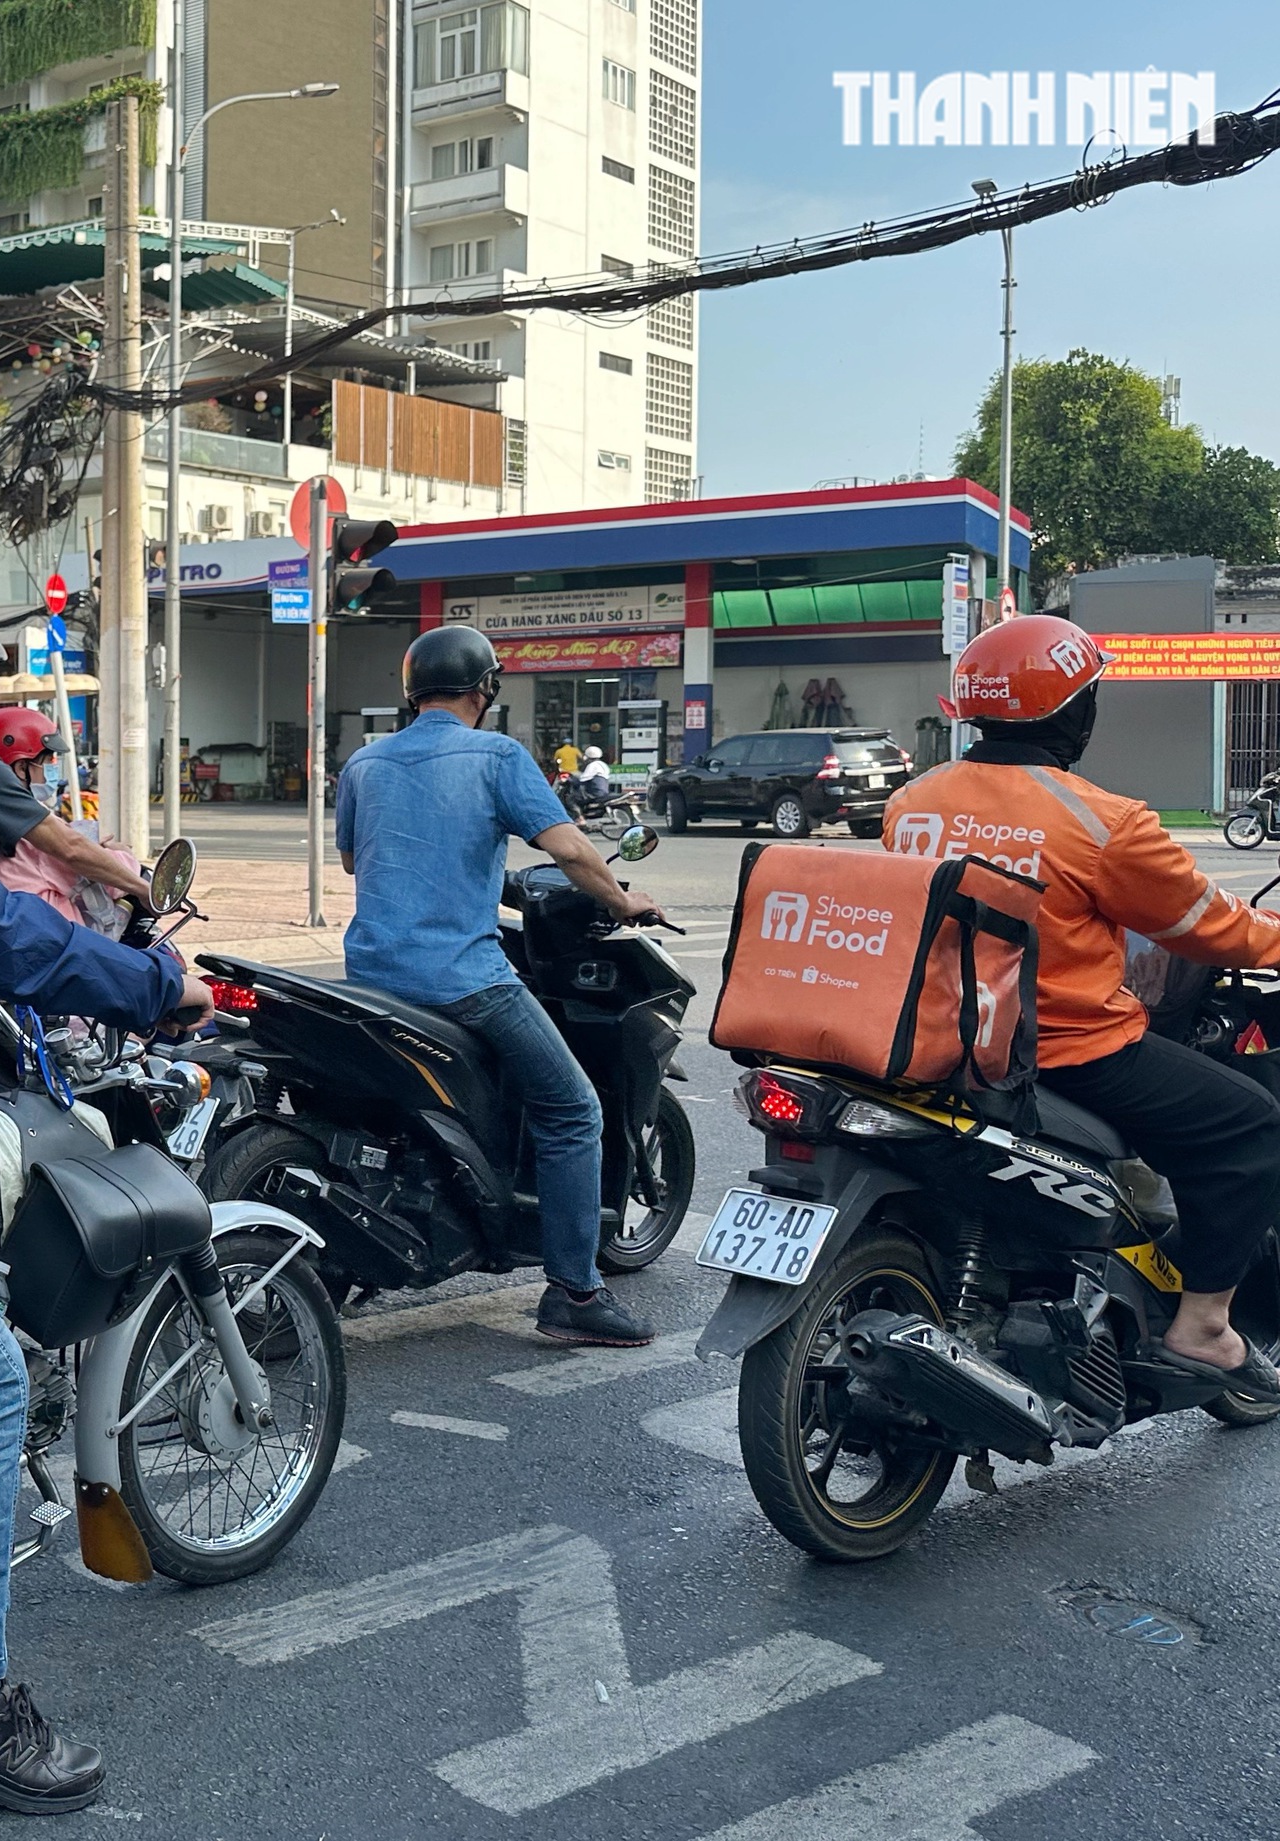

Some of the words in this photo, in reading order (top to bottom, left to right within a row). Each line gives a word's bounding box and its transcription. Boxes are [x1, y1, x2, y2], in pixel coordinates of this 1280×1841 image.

[147, 563, 222, 583] PTRO
[628, 609, 642, 620] 13
[971, 674, 1009, 688] Shopee
[972, 685, 1010, 699] Food
[950, 814, 1046, 847] Shopee
[944, 840, 1041, 880] Fod
[815, 895, 894, 925] Shopee
[807, 919, 888, 956] Food
[819, 973, 860, 990] Shopee
[733, 1198, 815, 1240] 60-AD
[710, 1230, 809, 1278] 137.18
